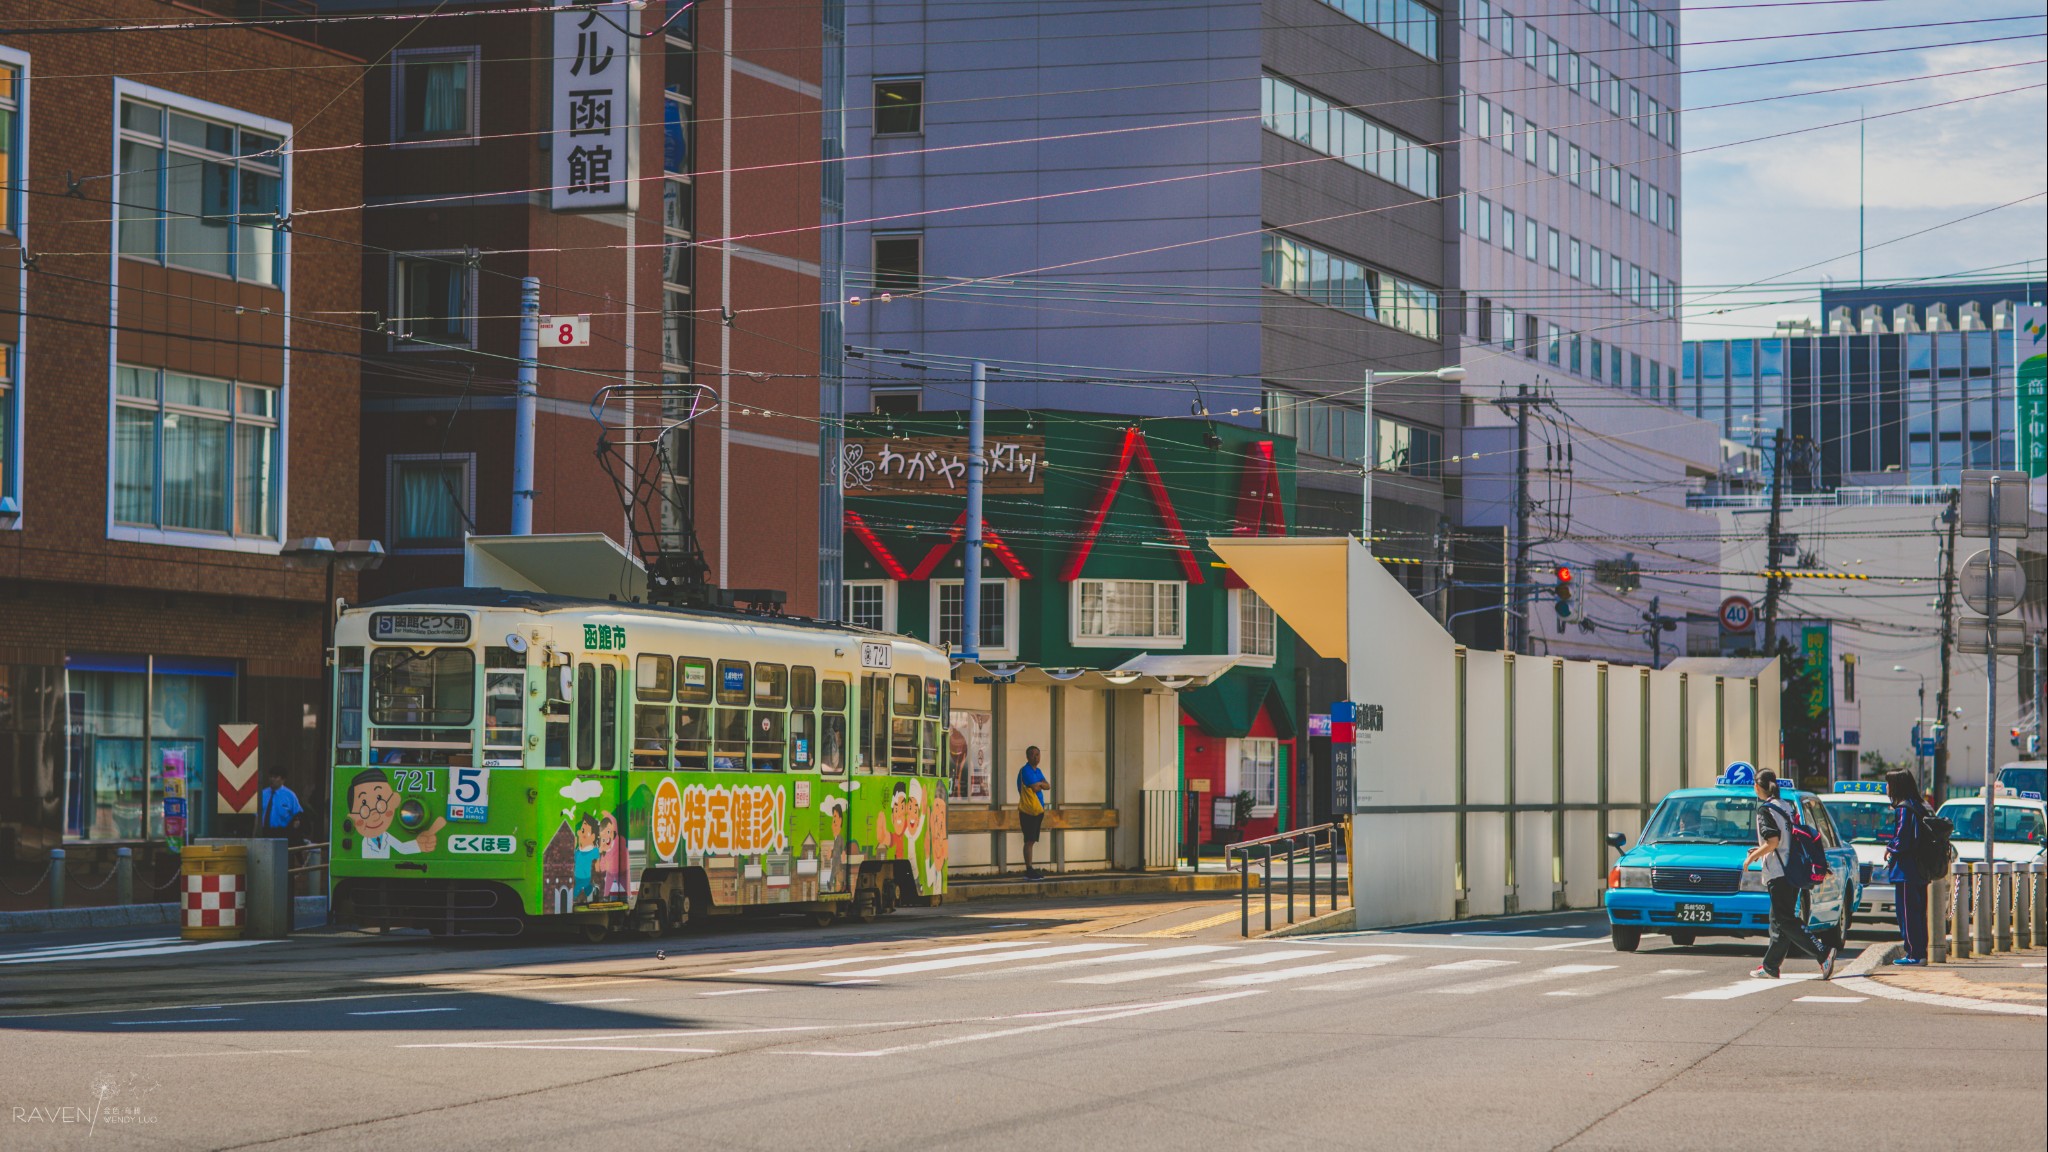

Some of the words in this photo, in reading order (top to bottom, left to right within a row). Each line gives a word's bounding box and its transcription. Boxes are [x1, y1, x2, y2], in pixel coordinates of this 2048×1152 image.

[558, 323, 574, 345] 8
[2028, 378, 2044, 458] 商工中金
[380, 616, 392, 631] 5
[1726, 605, 1747, 623] 40
[583, 624, 626, 650] 函館市
[873, 645, 889, 666] 721
[394, 770, 436, 792] 721
[455, 769, 481, 803] 5
[1335, 750, 1348, 807] 函館駅前
[1843, 782, 1883, 792] いさり火
[465, 806, 485, 814] ICAS
[657, 797, 677, 816] 受けて
[656, 817, 677, 843] 安心
[453, 837, 511, 852] こくほ号
[1683, 910, 1712, 921] 24-29
